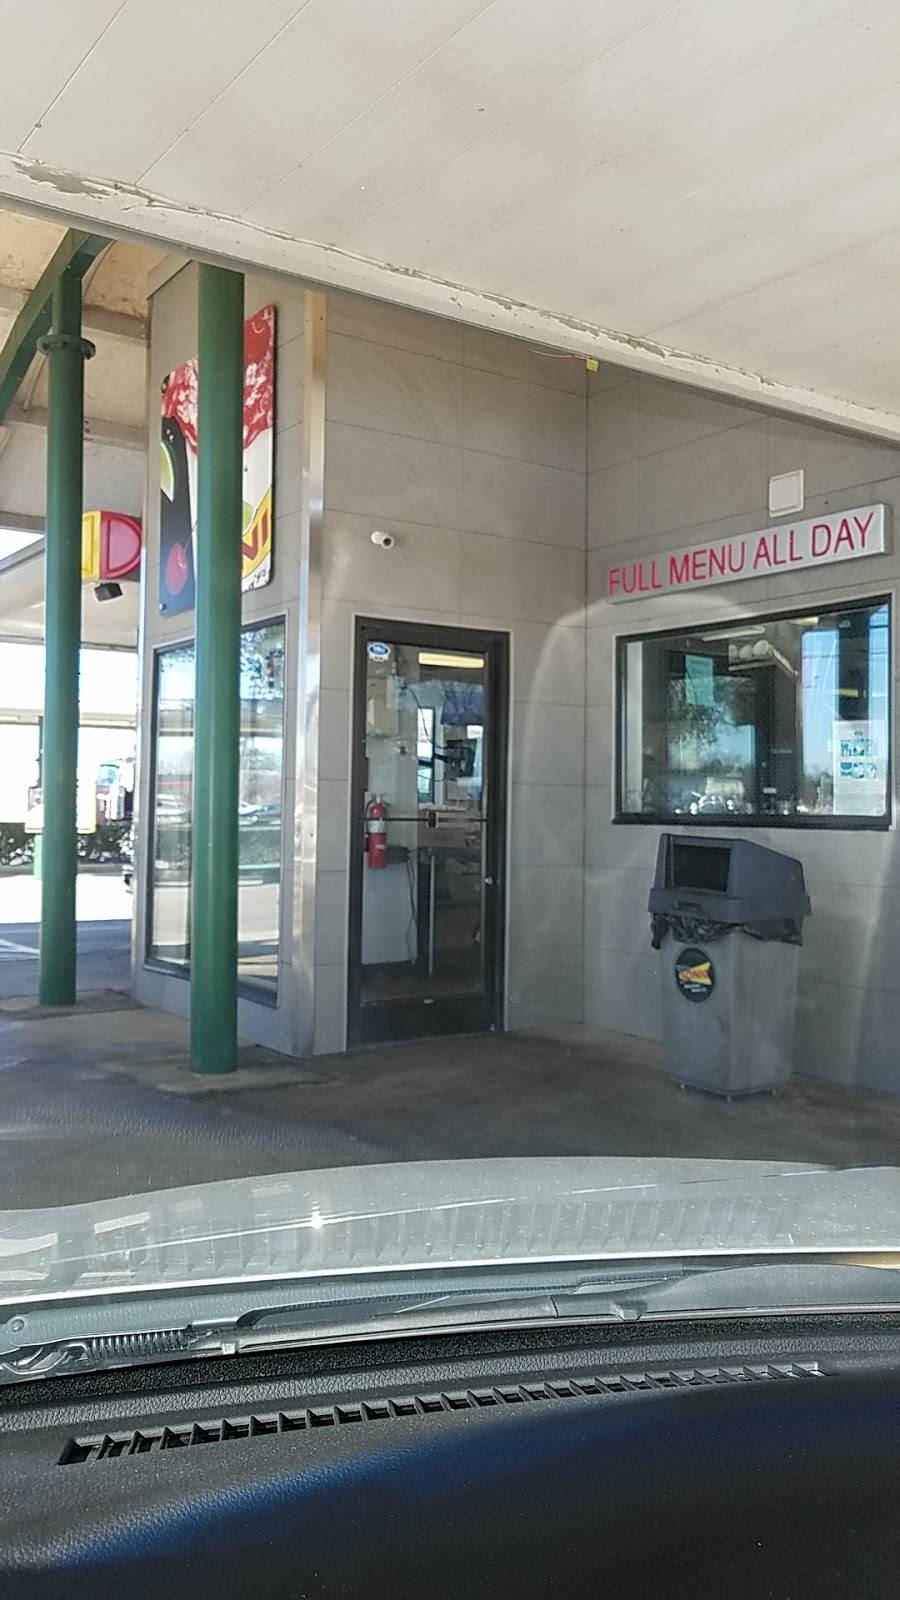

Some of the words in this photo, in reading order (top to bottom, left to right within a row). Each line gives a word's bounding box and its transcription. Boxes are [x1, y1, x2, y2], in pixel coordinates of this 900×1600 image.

[608, 560, 662, 596] FULL
[669, 541, 746, 586] MENU
[753, 530, 803, 570] ALL
[811, 511, 874, 558] DAY
